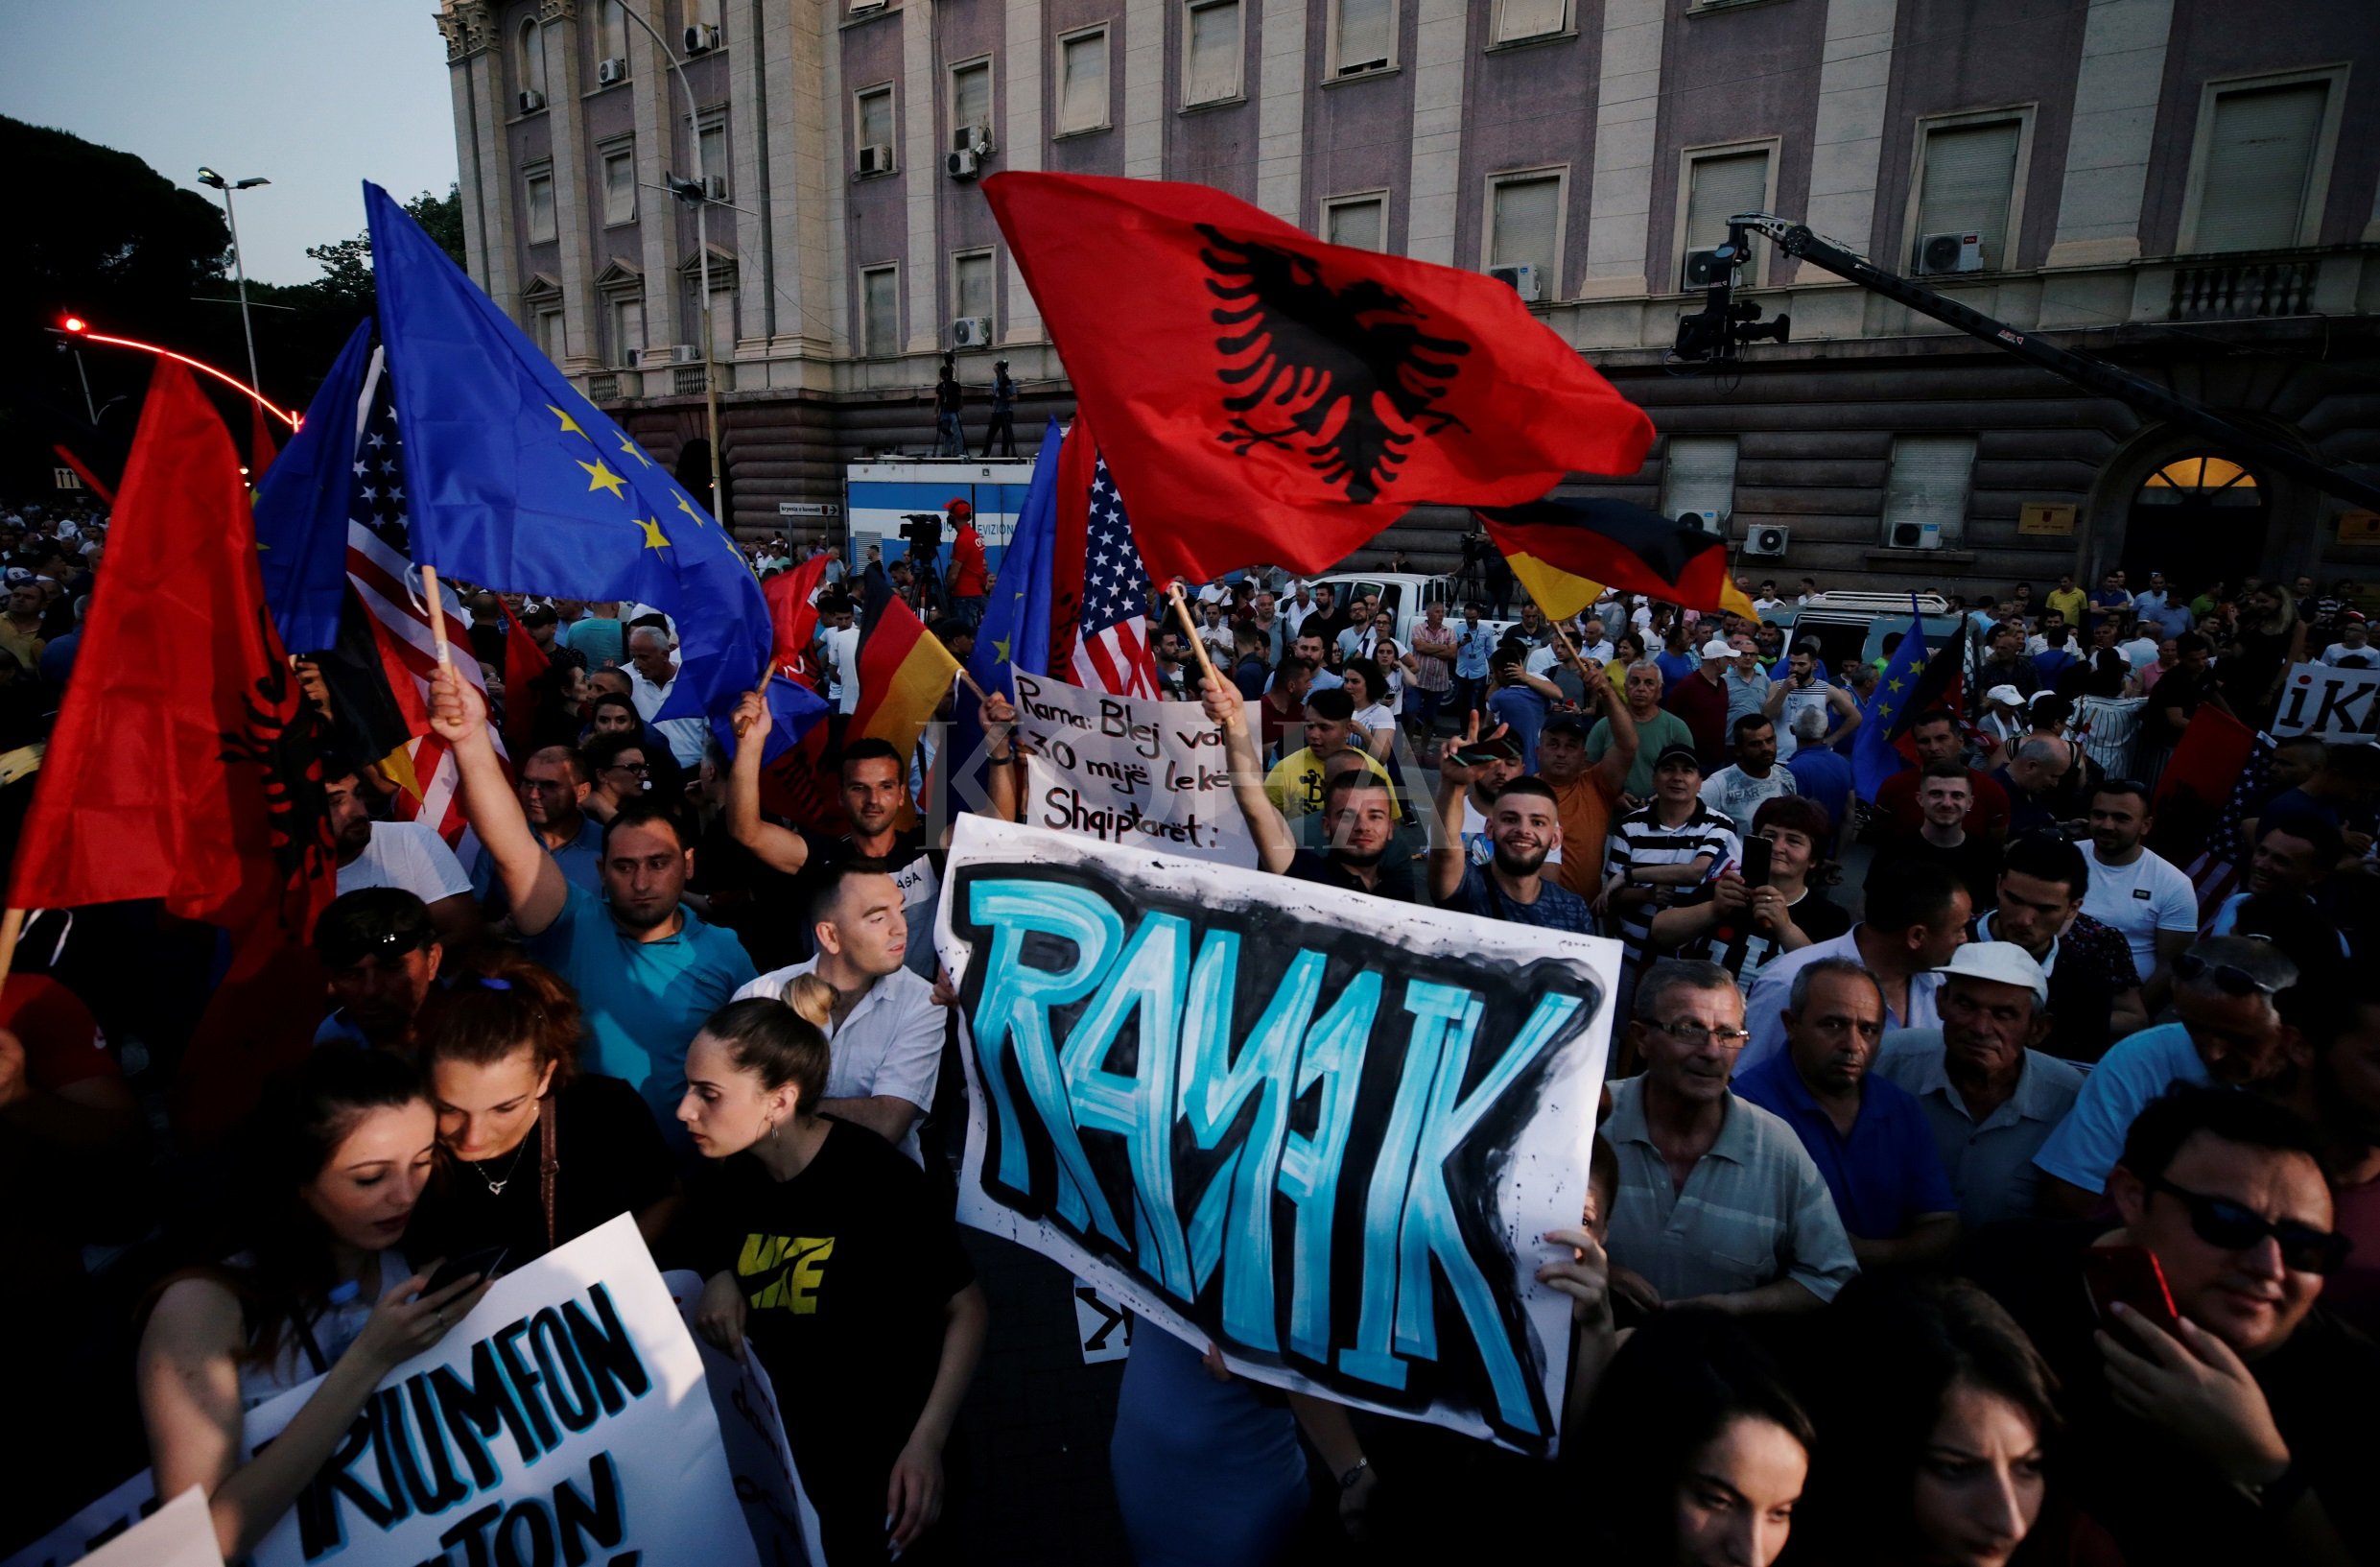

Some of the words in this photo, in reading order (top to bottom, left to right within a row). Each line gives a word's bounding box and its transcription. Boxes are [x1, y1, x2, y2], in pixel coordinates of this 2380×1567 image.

[1016, 676, 1093, 730] Rama:
[1099, 699, 1161, 760] Blej
[2278, 675, 2377, 733] iK
[1027, 730, 1076, 771] 30
[1086, 759, 1150, 795] mijë
[1165, 759, 1230, 792] lekë
